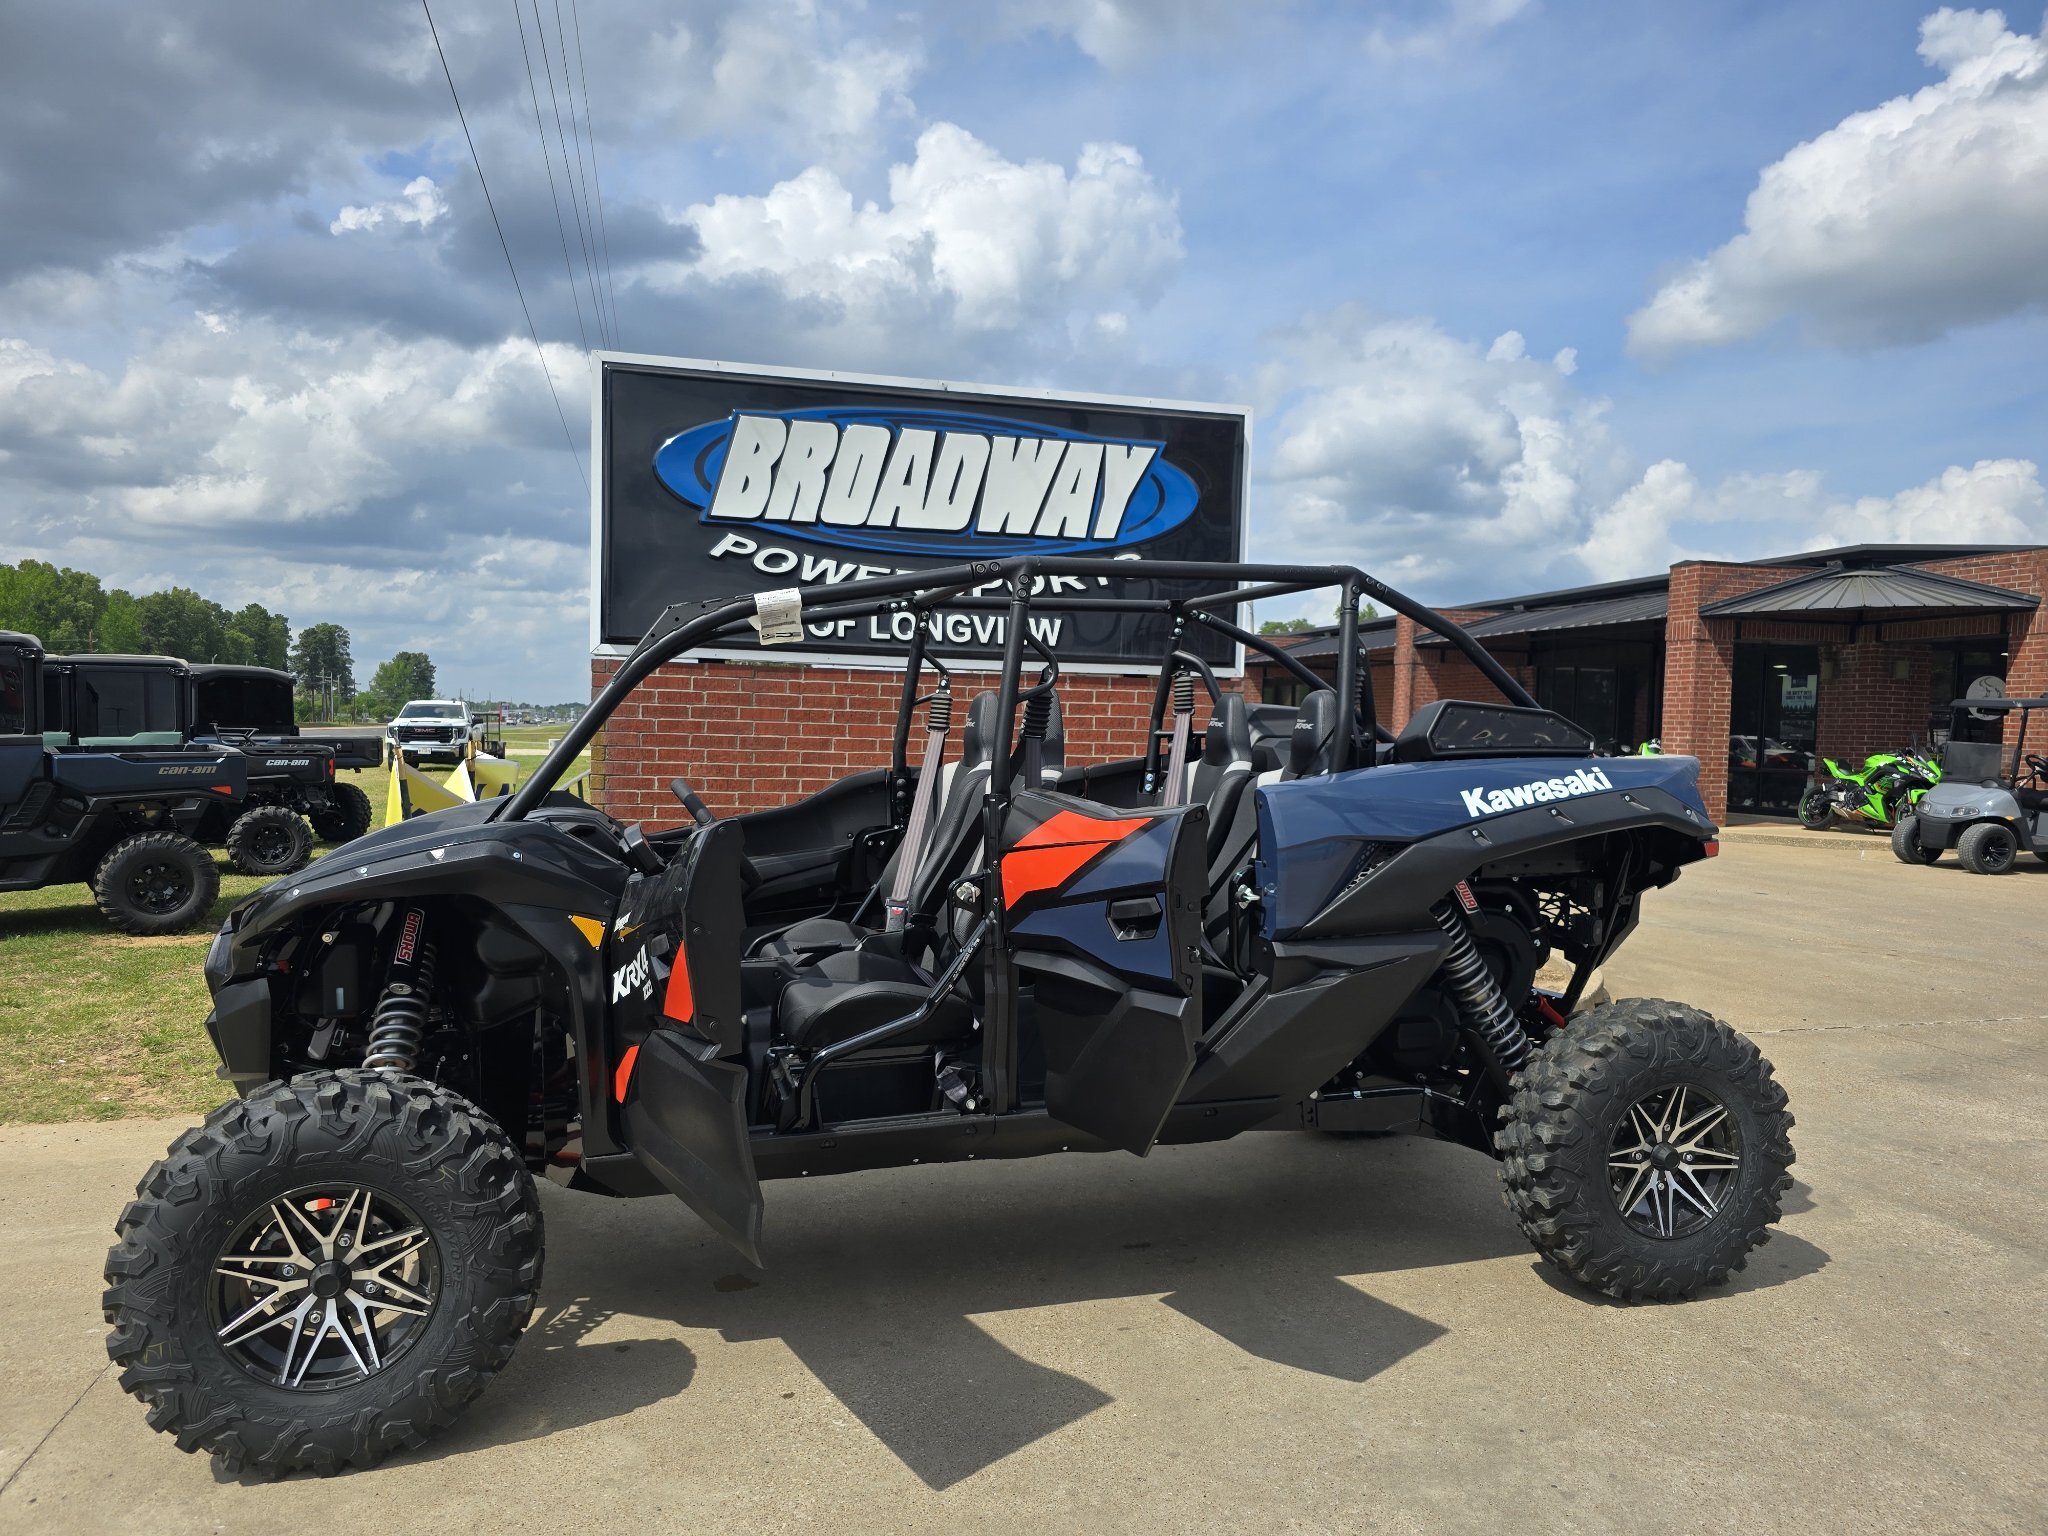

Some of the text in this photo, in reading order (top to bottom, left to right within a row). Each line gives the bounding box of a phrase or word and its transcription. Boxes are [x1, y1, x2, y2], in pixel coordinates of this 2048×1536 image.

[709, 415, 1158, 539] BROADWAY
[807, 611, 1063, 647] OF LONGVIW
[158, 765, 218, 775] can-am
[1460, 766, 1613, 818] Kawasaki
[1455, 880, 1478, 909] OWA
[398, 912, 420, 962] SHOWA
